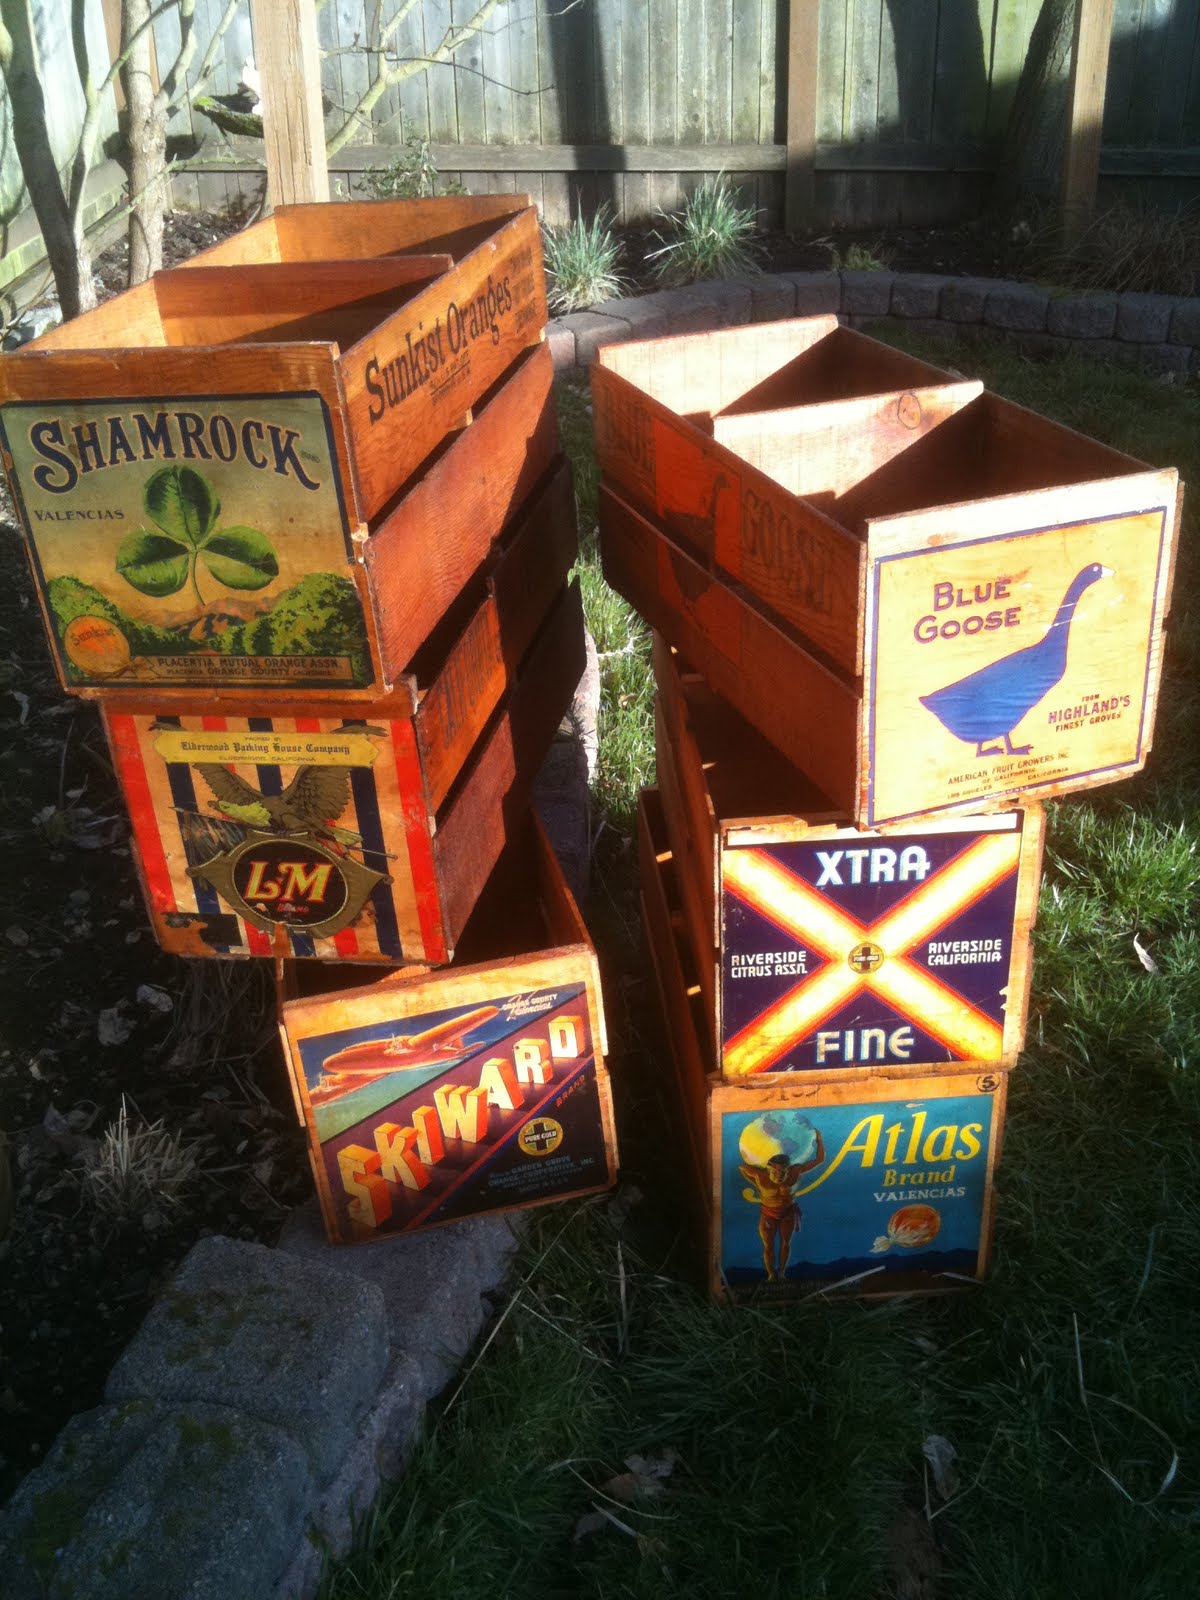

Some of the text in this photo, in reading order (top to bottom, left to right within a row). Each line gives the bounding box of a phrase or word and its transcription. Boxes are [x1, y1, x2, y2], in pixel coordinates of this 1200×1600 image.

[365, 317, 446, 425] Sunkist
[447, 275, 513, 345] Oranges
[31, 411, 321, 493] SHAMROCK
[34, 509, 125, 521] VALENCIAS
[933, 578, 1011, 612] BLUE
[914, 607, 1021, 644] GOOSE
[157, 658, 214, 667] PLACENTIA
[220, 658, 261, 668] MUTUAL
[265, 658, 306, 668] ORANGE
[251, 668, 289, 676] COUNTY
[1082, 694, 1100, 702] FROM
[1048, 695, 1131, 724] HIGHLAND'S
[1056, 712, 1122, 732] FINEST GROVES
[233, 742, 270, 754] Packing
[273, 743, 302, 752] House
[305, 744, 351, 755] Company
[948, 770, 988, 784] AMERICAN
[992, 763, 1015, 774] FRUIT
[1018, 755, 1054, 768] GROWERS
[816, 846, 930, 886] XTRA
[928, 939, 1002, 954] RIVERSIDE
[731, 951, 807, 967] RIVERSIDE
[928, 952, 1002, 966] CALIFORNIA
[731, 964, 772, 979] CITRUS
[531, 993, 558, 1004] COUNTY
[816, 1026, 914, 1063] FINE
[337, 1015, 585, 1228] SKIWARD
[525, 1130, 557, 1143] PURE GOLD
[812, 1111, 982, 1181] Atlas
[883, 1165, 956, 1187] Brand
[873, 1187, 966, 1202] VALENCIAS
